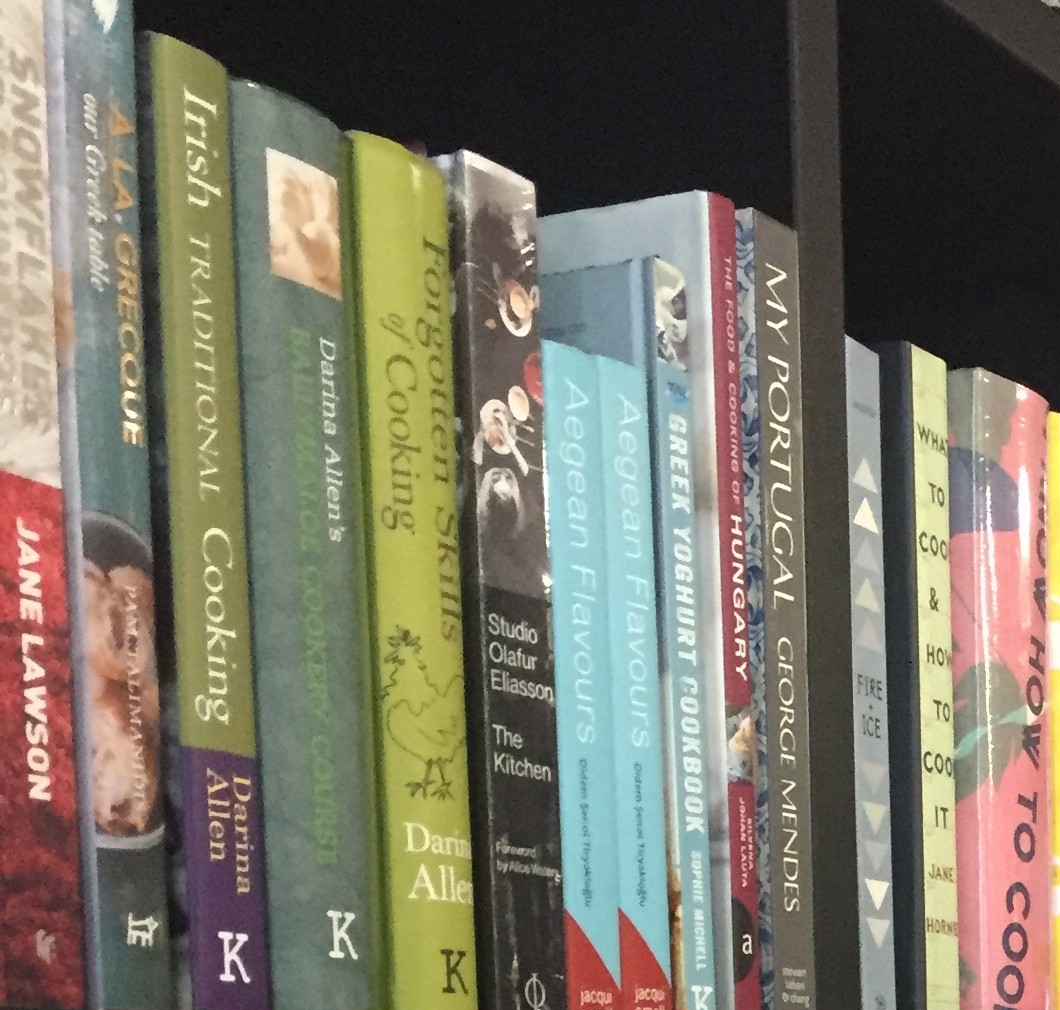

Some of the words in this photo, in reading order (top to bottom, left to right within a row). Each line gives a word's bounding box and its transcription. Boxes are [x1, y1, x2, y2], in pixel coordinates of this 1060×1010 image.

[183, 86, 223, 208] Irish
[723, 256, 734, 292] THE
[764, 261, 789, 346] MY
[113, 232, 145, 447] GRECQUE
[189, 234, 221, 494] TRADITIONAL
[724, 298, 736, 354] FOOD
[727, 359, 737, 374] &
[318, 336, 339, 437] Darina
[727, 381, 740, 473] COOKING
[381, 354, 423, 537] Cooking
[559, 376, 590, 551] Aegean
[613, 392, 643, 561] Aegean
[668, 412, 691, 516] GREEK
[767, 354, 795, 611] PORTUGAL
[325, 445, 344, 544] Allen's
[730, 479, 741, 507] OF
[928, 481, 946, 506] TO
[15, 516, 44, 627] JANE
[671, 525, 698, 668] YOGHURT
[730, 514, 748, 682] HUNGARY
[928, 586, 941, 613] &
[195, 527, 237, 726] Cooking
[487, 613, 539, 645] Studio
[488, 641, 538, 671] Olafur
[570, 562, 597, 746] Flavours
[624, 572, 651, 749] Flavours
[20, 635, 52, 803] LAWSON
[490, 669, 555, 703] Eliasson
[777, 636, 797, 769] GEORGE
[855, 673, 883, 701] FIRE
[861, 713, 882, 740] ICE
[933, 698, 951, 724] TO
[1022, 634, 1048, 771] HOW
[491, 723, 524, 751] The
[493, 753, 553, 783] Kitchen
[677, 674, 705, 835] COOKBOOK
[206, 767, 229, 862] Allen
[231, 776, 252, 896] Darina
[779, 779, 801, 914] MENDES
[934, 804, 950, 830] IT
[1012, 791, 1040, 864] TO
[690, 850, 704, 905] SOPHIE
[217, 931, 251, 984] K
[327, 910, 359, 960] K
[440, 948, 469, 995] K
[741, 932, 755, 956] a
[634, 986, 667, 1010] jacqui
